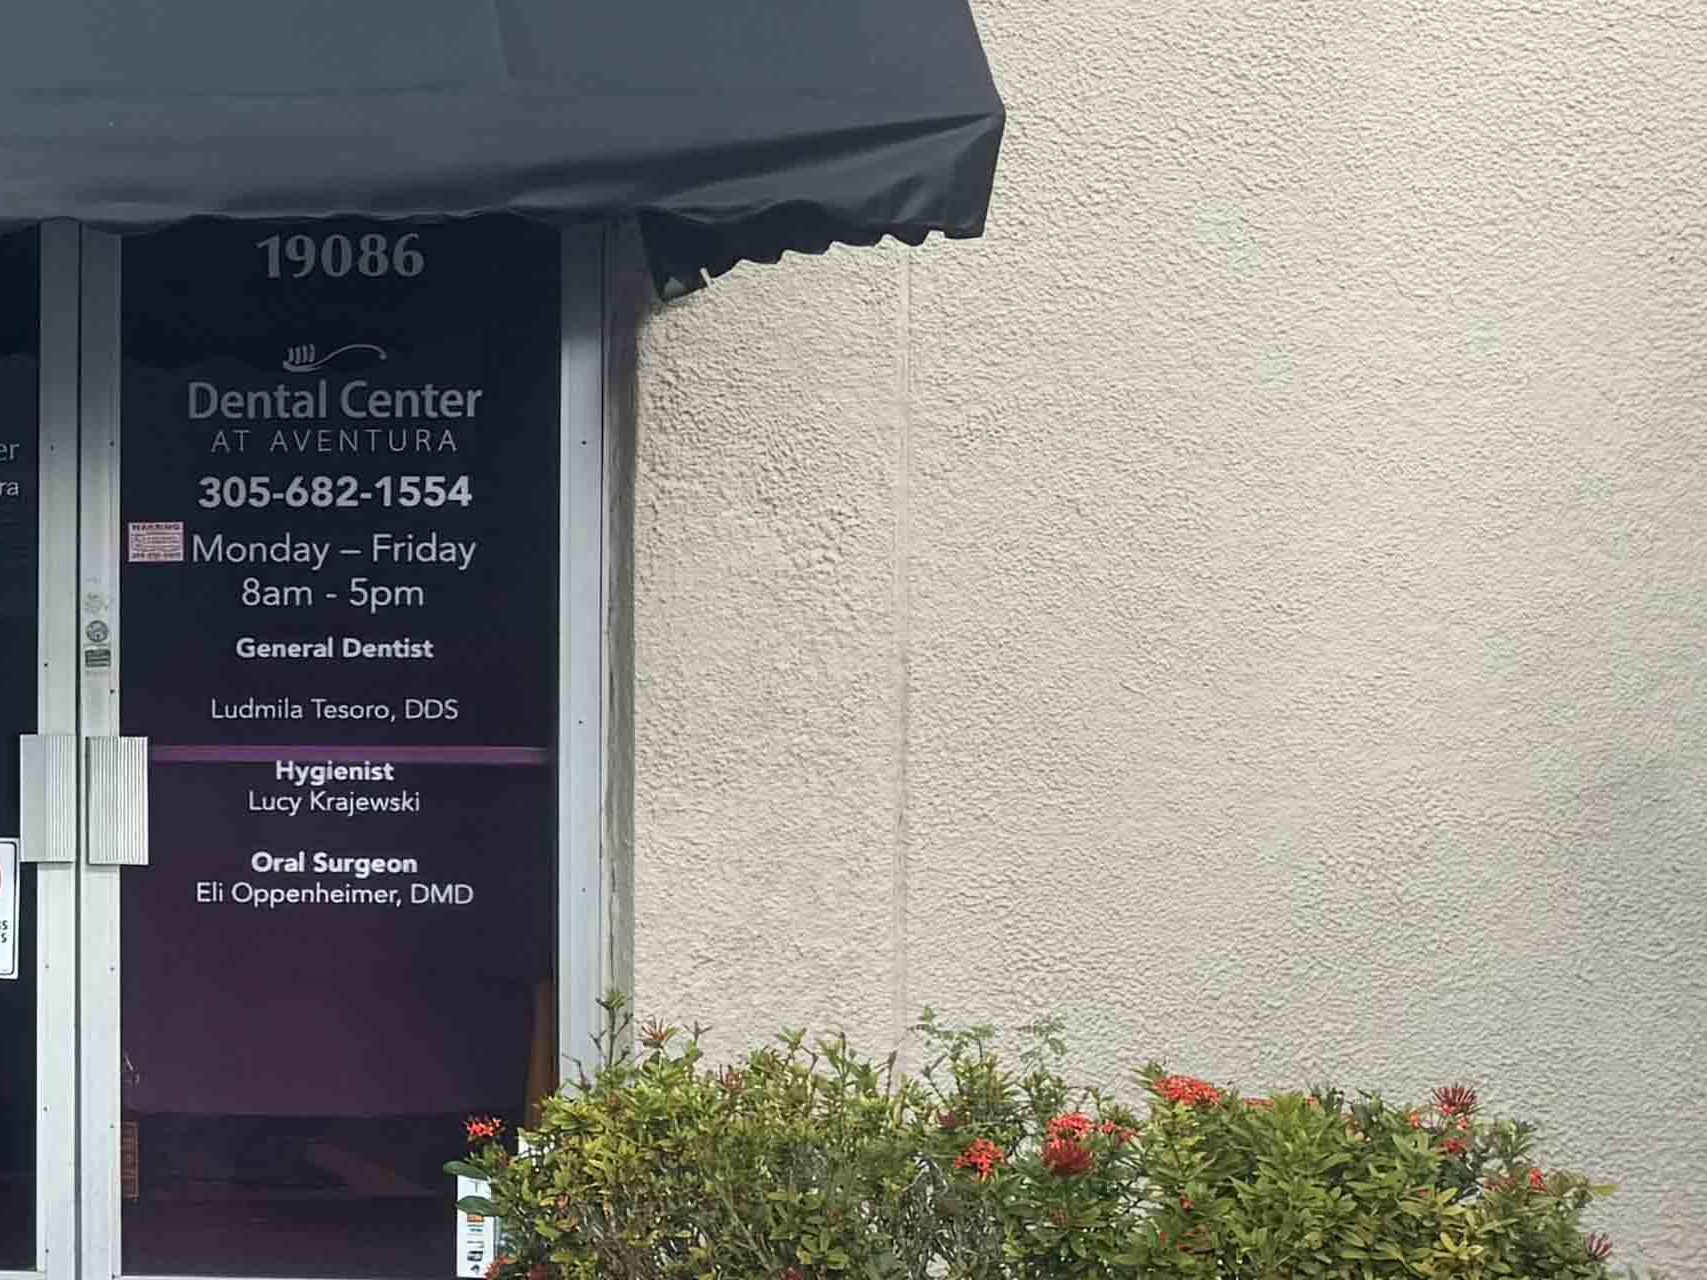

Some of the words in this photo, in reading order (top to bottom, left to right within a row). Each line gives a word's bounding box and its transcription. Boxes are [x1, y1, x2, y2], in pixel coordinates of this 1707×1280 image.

[256, 232, 424, 279] 19086
[188, 380, 327, 419] Dental
[340, 380, 483, 419] Center
[210, 429, 251, 453] AT
[269, 428, 458, 453] AVENTURA
[198, 475, 473, 509] 305-682-1554
[192, 533, 330, 570] Monday
[372, 532, 476, 570] Friday
[241, 578, 313, 606] 8am
[348, 578, 424, 613] 5pm
[236, 637, 334, 658] General
[342, 637, 434, 659] Dentist
[211, 697, 303, 719] Ludmila
[311, 699, 396, 723] Tesoro,
[405, 699, 459, 720] DDS
[275, 760, 394, 786] Hygienist
[249, 791, 302, 816] Lucy
[310, 790, 420, 815] Krajewski
[251, 851, 305, 873] Oral
[313, 852, 418, 878] Surgeon
[197, 882, 223, 904] Eli
[231, 882, 402, 909] Oppenheimer,
[410, 884, 474, 905] DMD
